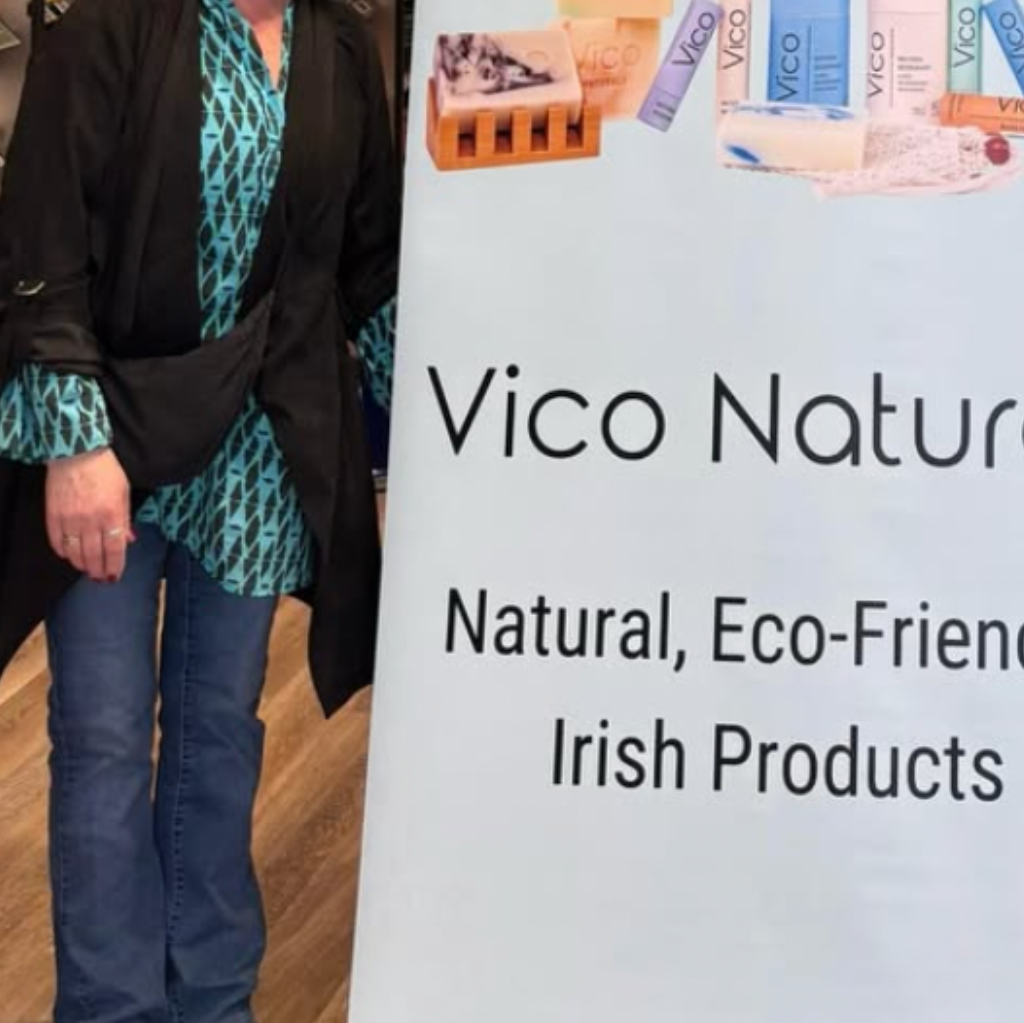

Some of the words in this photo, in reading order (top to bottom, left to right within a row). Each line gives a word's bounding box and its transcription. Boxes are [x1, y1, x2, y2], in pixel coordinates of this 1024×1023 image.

[672, 10, 716, 69] Vico
[722, 8, 747, 71] Vico
[776, 32, 801, 102] Vico
[867, 31, 886, 99] Vico
[953, 7, 977, 69] Vico
[427, 365, 665, 461] Vico
[445, 588, 686, 672] Natural,
[552, 718, 685, 790] Irish
[712, 724, 1004, 802] Products
